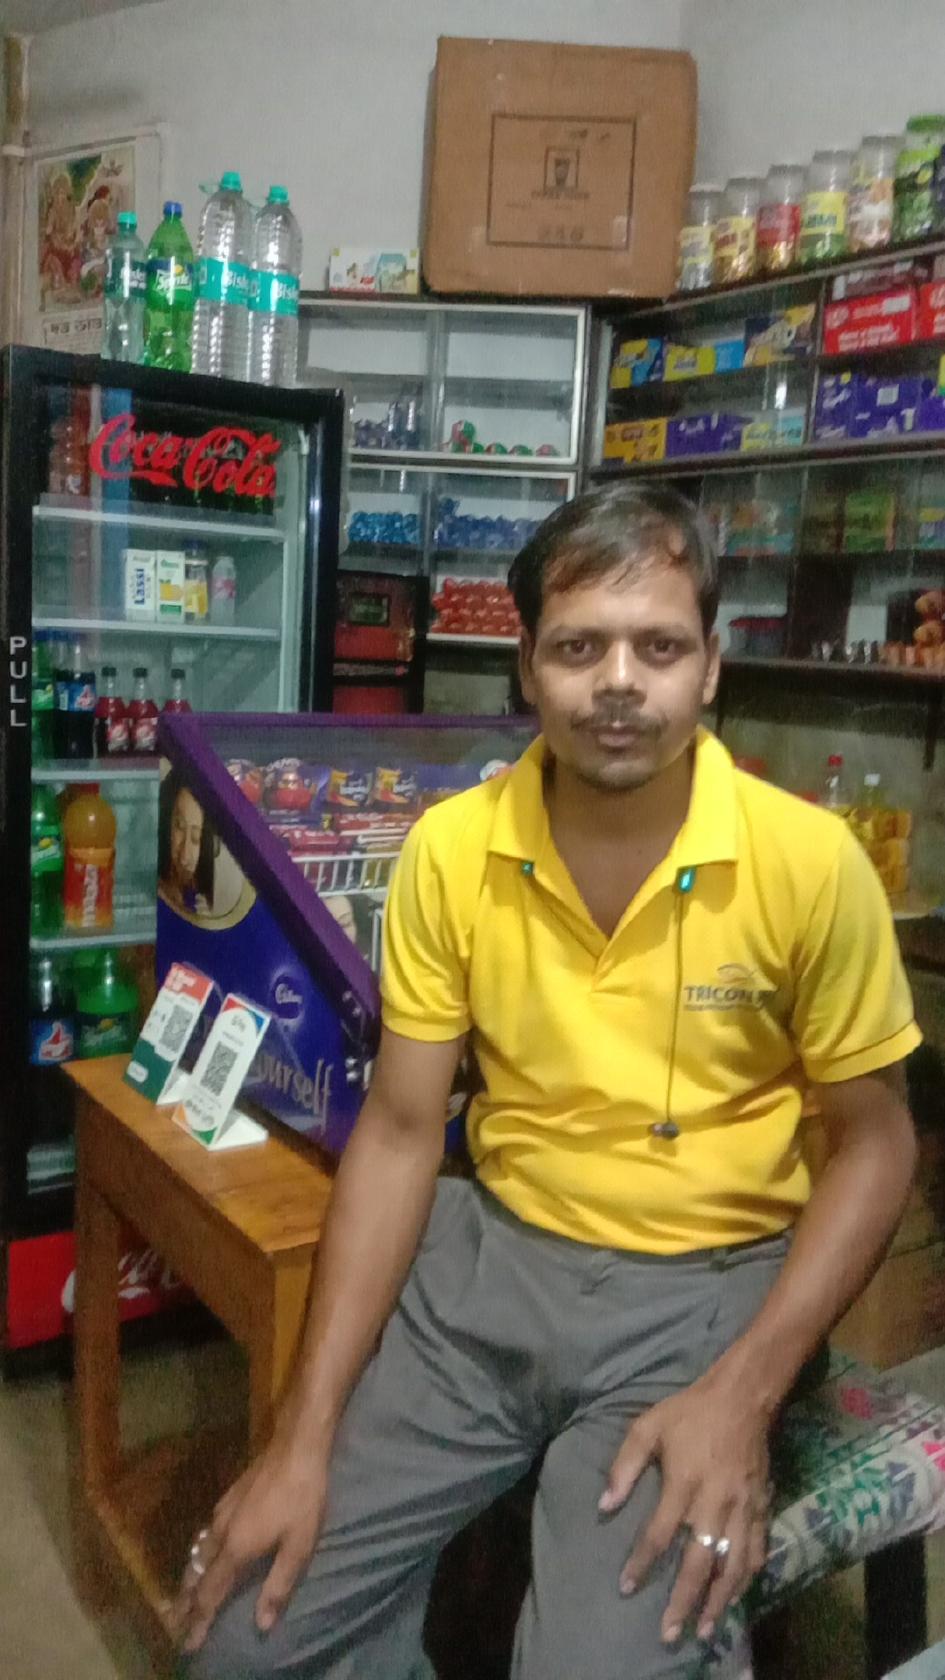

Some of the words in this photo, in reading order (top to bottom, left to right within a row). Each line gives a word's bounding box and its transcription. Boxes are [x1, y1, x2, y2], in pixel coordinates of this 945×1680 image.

[89, 412, 281, 496] Coca-Cola
[134, 568, 145, 605] Lassi
[10, 636, 27, 727] PULL
